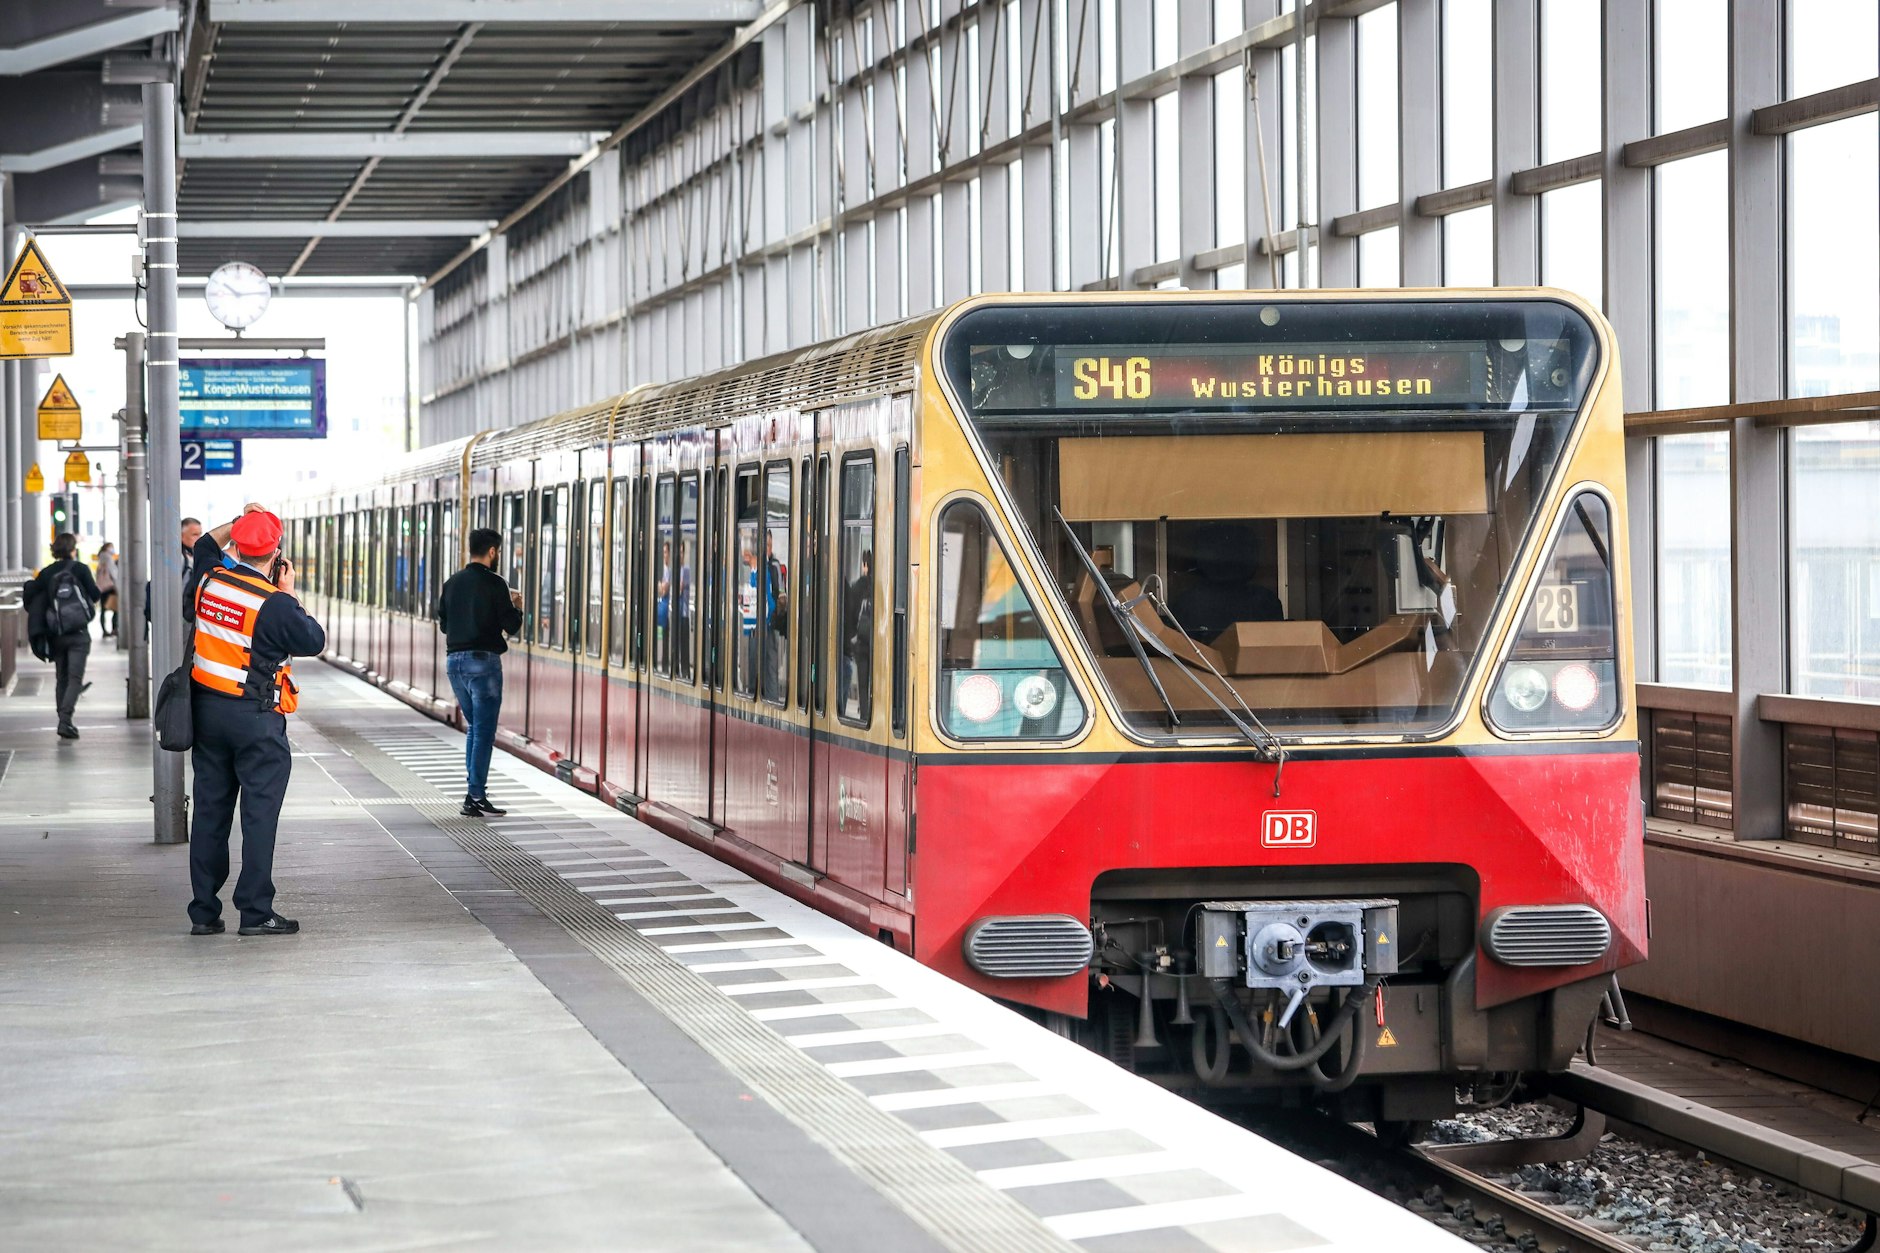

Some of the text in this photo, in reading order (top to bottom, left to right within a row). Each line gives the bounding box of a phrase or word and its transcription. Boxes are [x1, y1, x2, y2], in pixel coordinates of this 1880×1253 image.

[1259, 355, 1365, 377] Königs
[1073, 356, 1151, 400] S46
[1191, 376, 1432, 398] Wusterhausen
[184, 443, 201, 469] 2
[200, 596, 243, 616] Kundenbetreuer
[1538, 588, 1573, 628] 28
[216, 611, 223, 621] S
[224, 615, 239, 625] Bahn
[1270, 817, 1308, 840] DB
